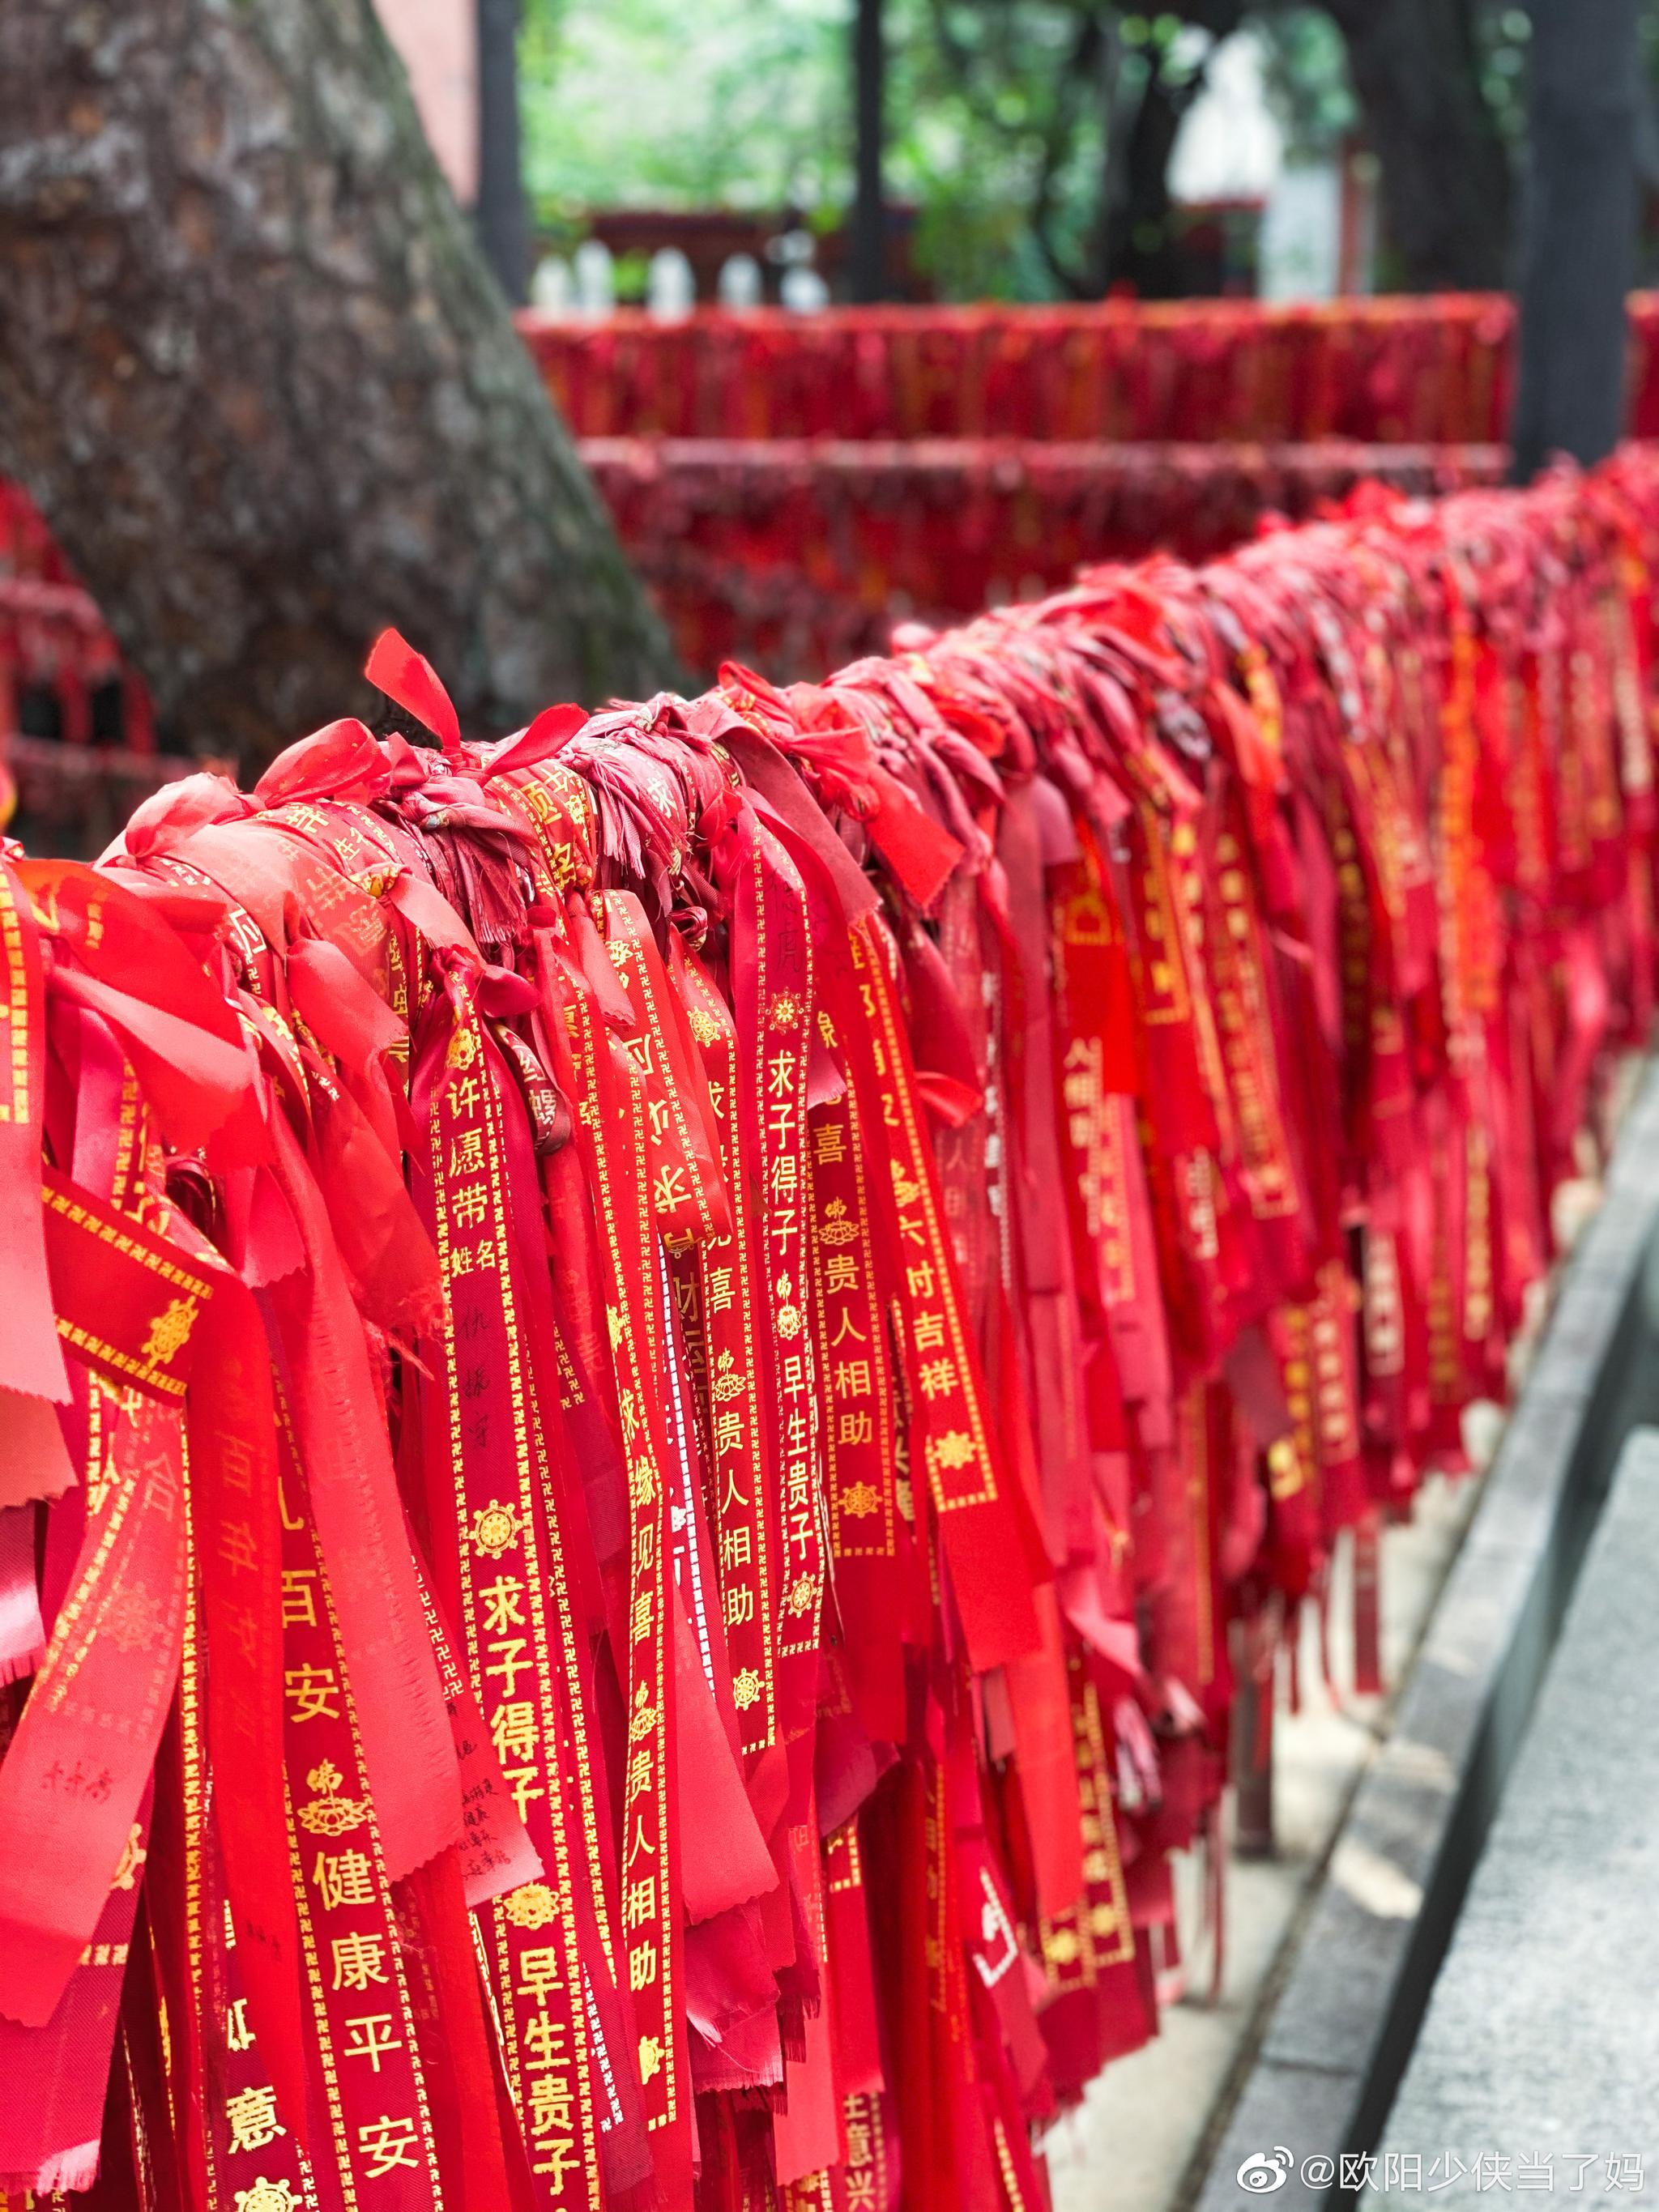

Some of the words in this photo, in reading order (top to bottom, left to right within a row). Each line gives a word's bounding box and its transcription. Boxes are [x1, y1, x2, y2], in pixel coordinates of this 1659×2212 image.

[446, 1080, 488, 1230] 许愿带
[450, 1242, 497, 1278] 姓名
[767, 1051, 799, 1256] 求子得子
[824, 1254, 873, 1446] 贵人相助
[622, 1388, 655, 1646] 求缘见喜
[716, 1412, 754, 1626] 贵人相助
[783, 1354, 814, 1561] 早生贵子
[479, 1575, 545, 1825] 求子得子
[627, 1750, 657, 1992] 贵人相助
[313, 1849, 420, 2178] 健康平安
[517, 1947, 580, 2195] 早生贵子
